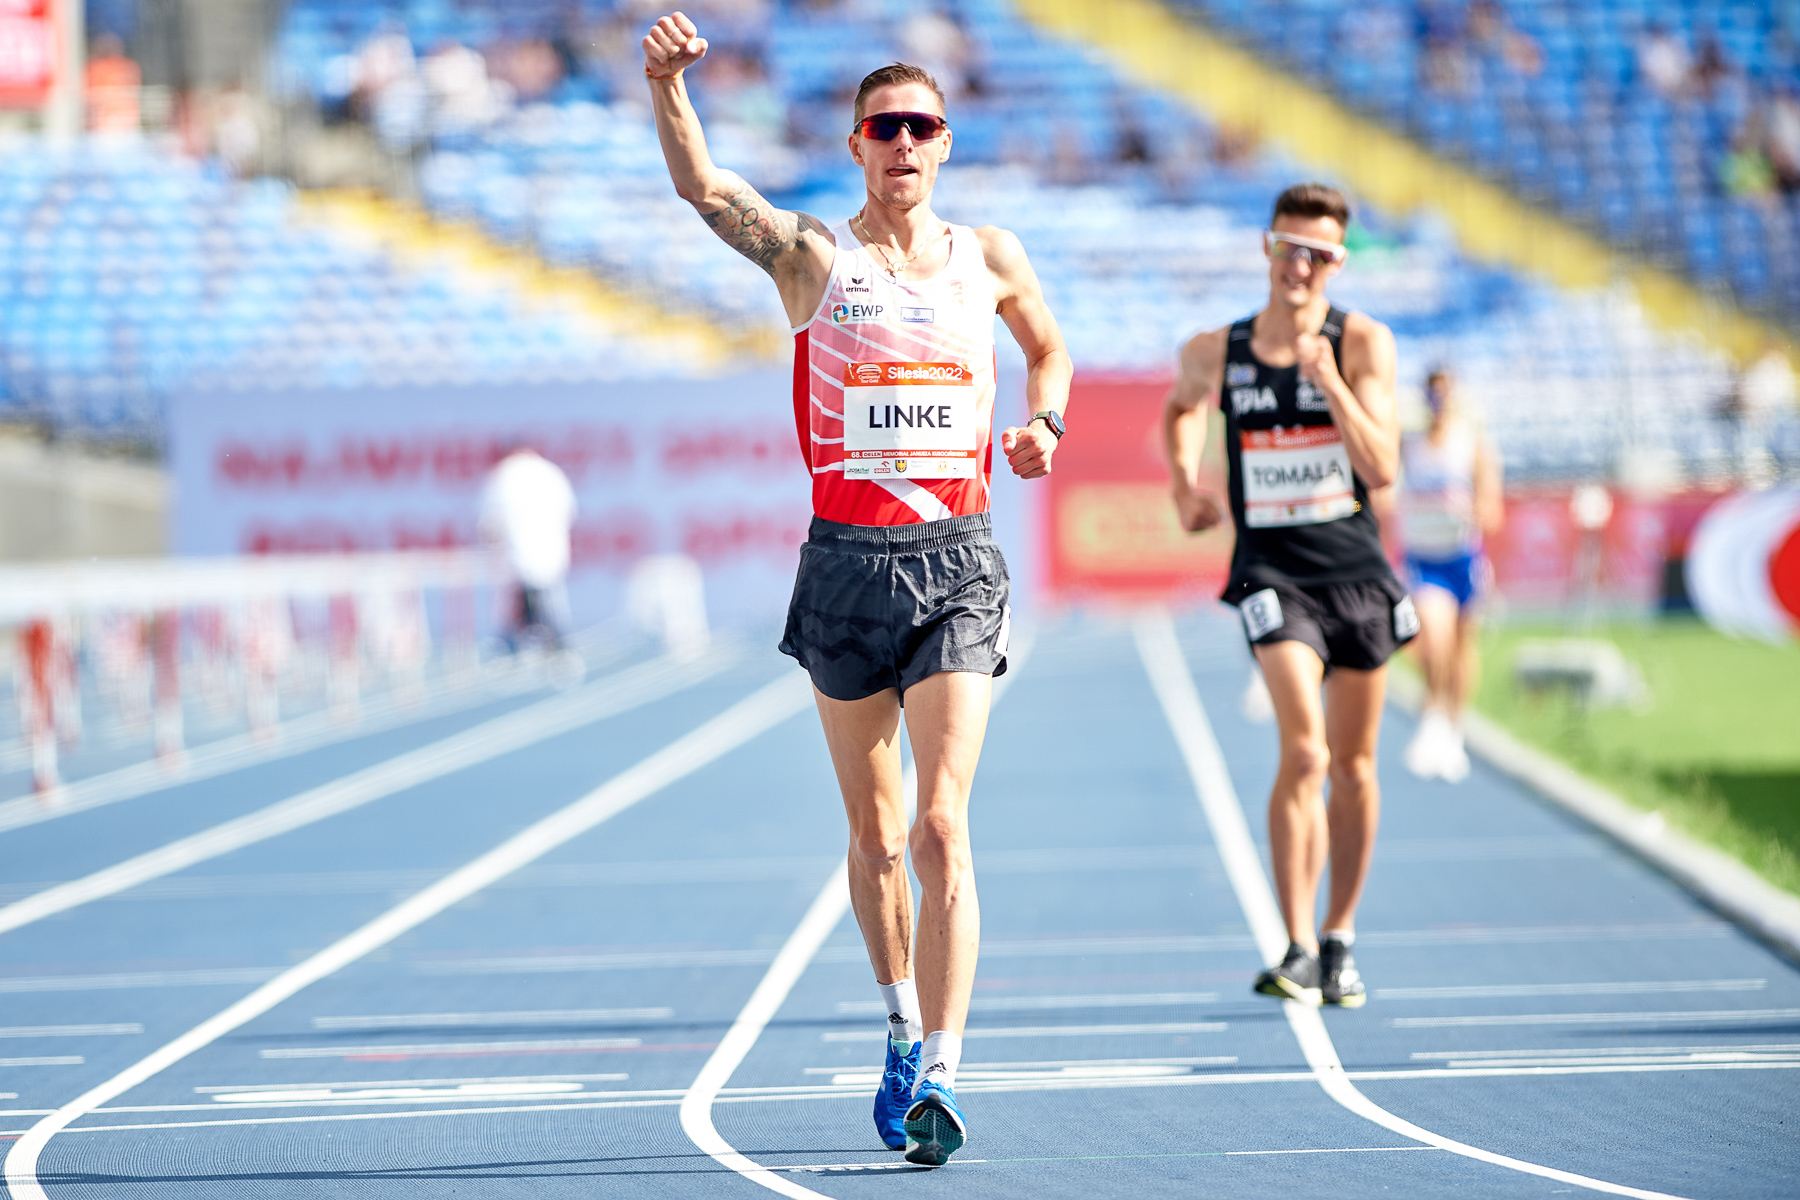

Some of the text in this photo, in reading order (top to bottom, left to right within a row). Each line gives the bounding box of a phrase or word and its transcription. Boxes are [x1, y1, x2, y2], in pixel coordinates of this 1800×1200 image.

[852, 305, 884, 317] EWP
[888, 367, 963, 380] Silesia2022
[869, 405, 952, 428] LINKE
[1252, 460, 1345, 488] TOMALA
